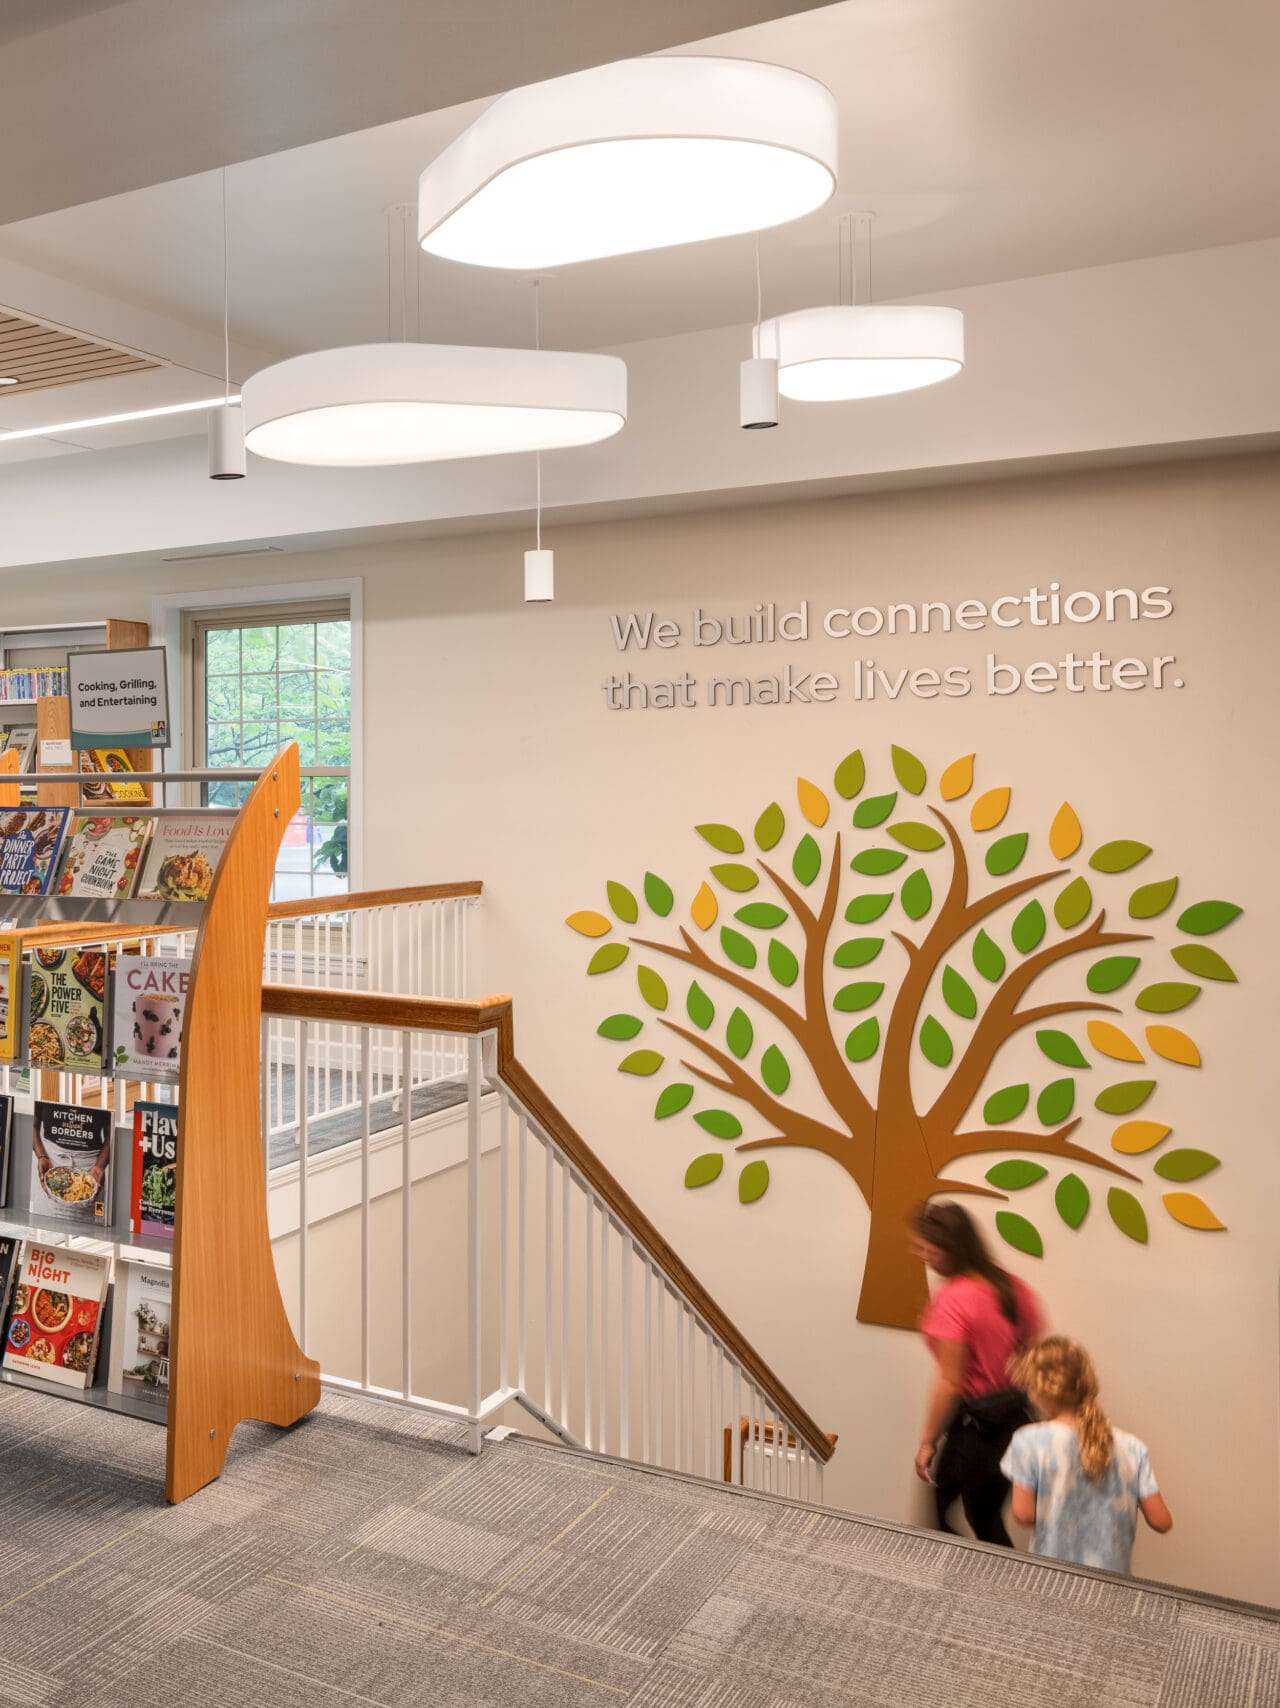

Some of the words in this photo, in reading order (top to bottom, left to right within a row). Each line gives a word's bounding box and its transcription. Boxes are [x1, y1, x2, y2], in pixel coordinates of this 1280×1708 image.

[610, 611, 680, 650] We
[693, 601, 809, 647] build
[823, 581, 1175, 639] connections
[78, 681, 118, 692] Cooking,
[120, 679, 157, 689] Grilling,
[602, 670, 696, 710] that
[708, 664, 839, 707] make
[854, 659, 972, 702] lives
[987, 651, 1186, 697] better.
[80, 698, 95, 707] and
[98, 695, 157, 707] Entertaining
[162, 825, 192, 836] Food
[3, 840, 35, 854] DINNER
[0, 853, 30, 870] PARTY
[95, 855, 120, 869] GAME
[0, 869, 34, 885] PROJECT
[89, 865, 116, 879] NIGHT
[81, 873, 116, 890] COOKBOOK
[51, 973, 67, 986] THE
[127, 969, 190, 993] CAKE
[51, 987, 82, 1001] POWER
[51, 1000, 70, 1014] FIVE
[53, 1111, 93, 1123] KITCHEN
[141, 1110, 178, 1137] Flav
[51, 1127, 94, 1139] BORDERS
[140, 1275, 170, 1289] Magnolia
